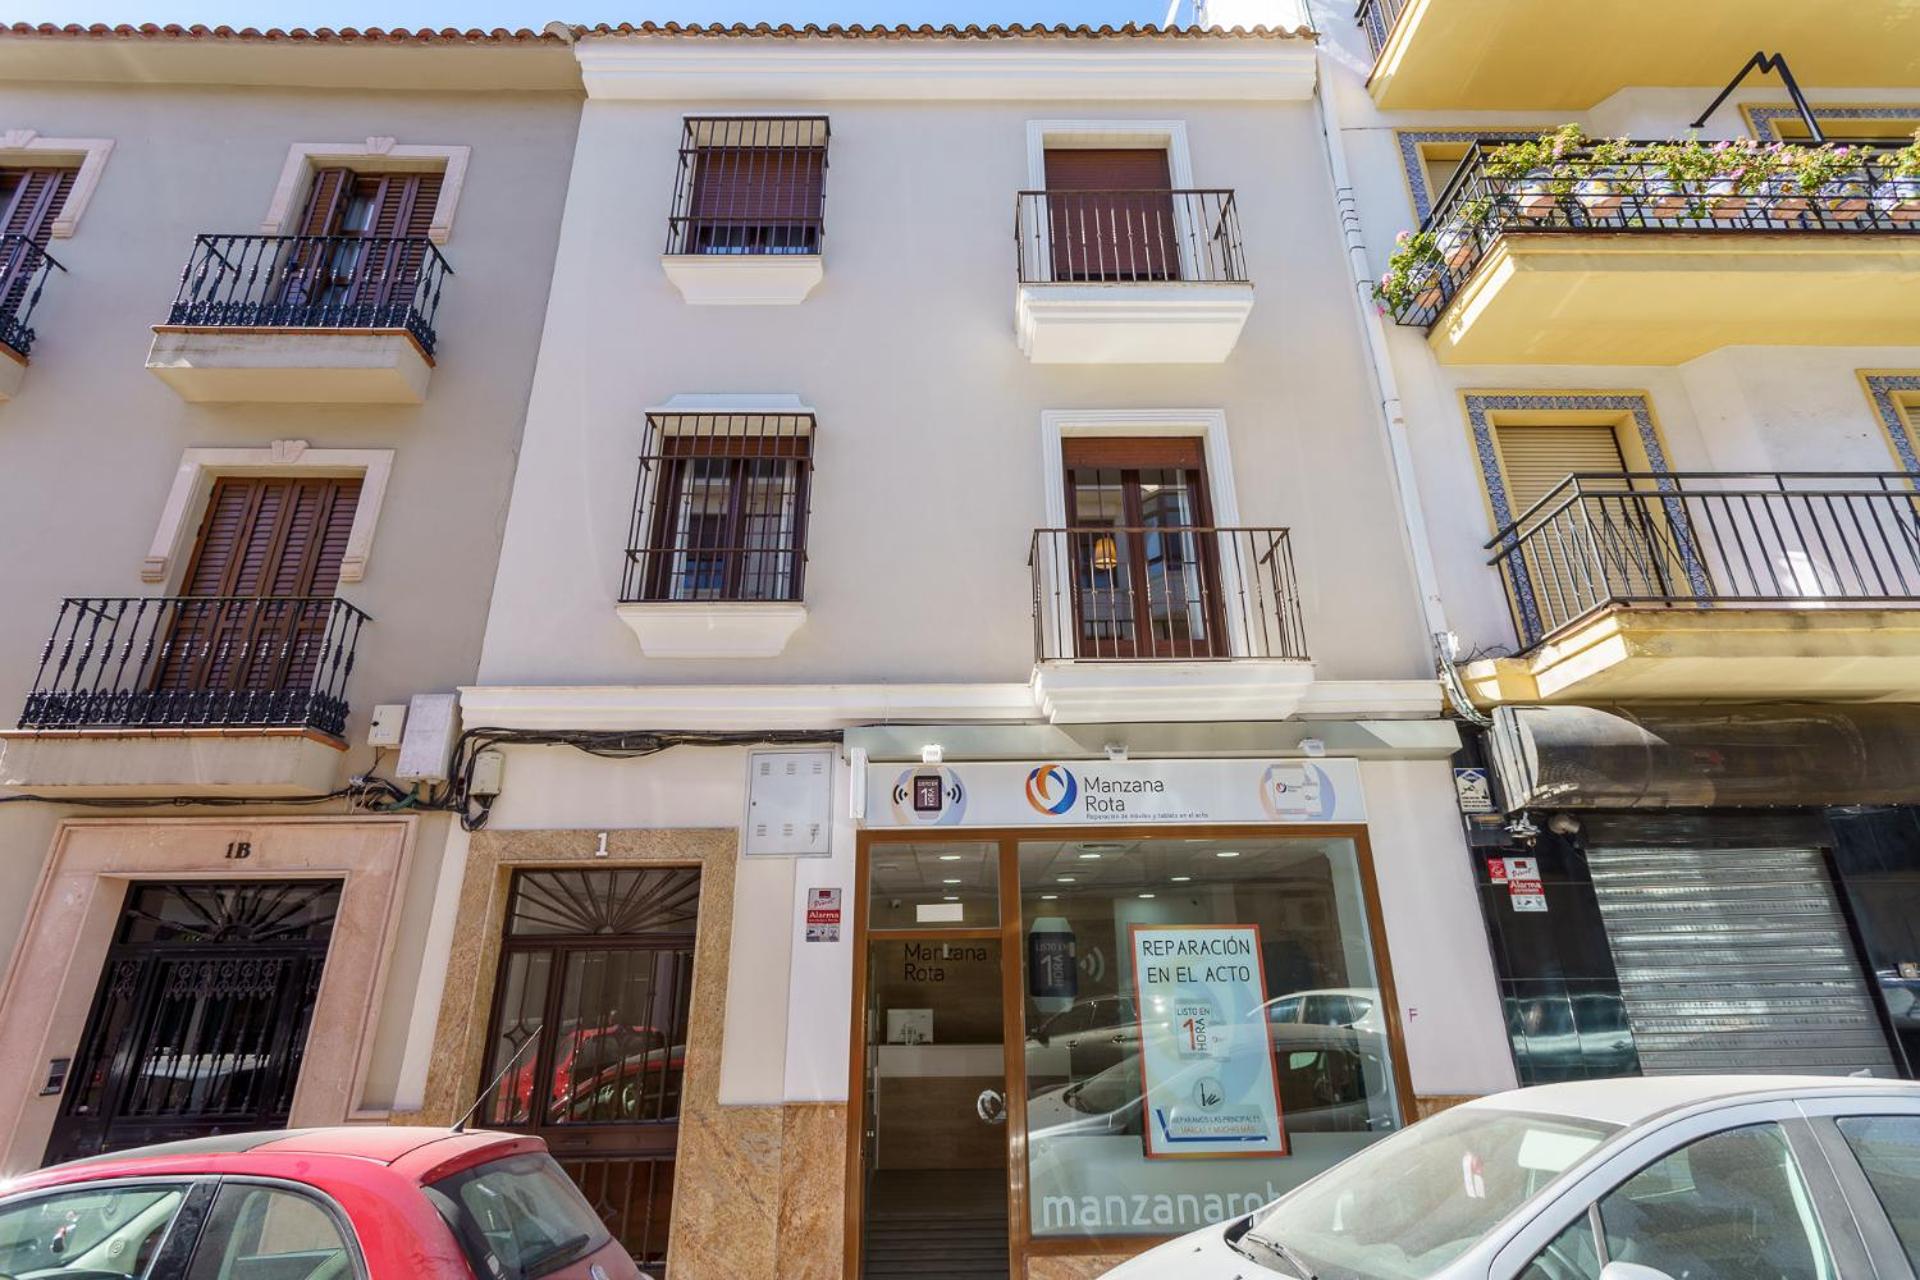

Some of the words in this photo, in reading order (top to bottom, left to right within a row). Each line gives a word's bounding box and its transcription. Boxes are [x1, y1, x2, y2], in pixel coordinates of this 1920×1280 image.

[1084, 776, 1165, 793] Manzana
[1085, 795, 1126, 812] Rota
[225, 842, 252, 859] 1B
[595, 832, 608, 857] 1
[808, 910, 840, 919] Alarma
[904, 943, 987, 962] Manzana
[1142, 936, 1251, 956] REPARACIÓN
[904, 963, 945, 983] Rota
[1147, 967, 1170, 983] EN
[1176, 967, 1198, 983] EL
[1205, 966, 1250, 982] ACTO
[1183, 1018, 1196, 1051] 1
[1195, 1018, 1207, 1051] HORA
